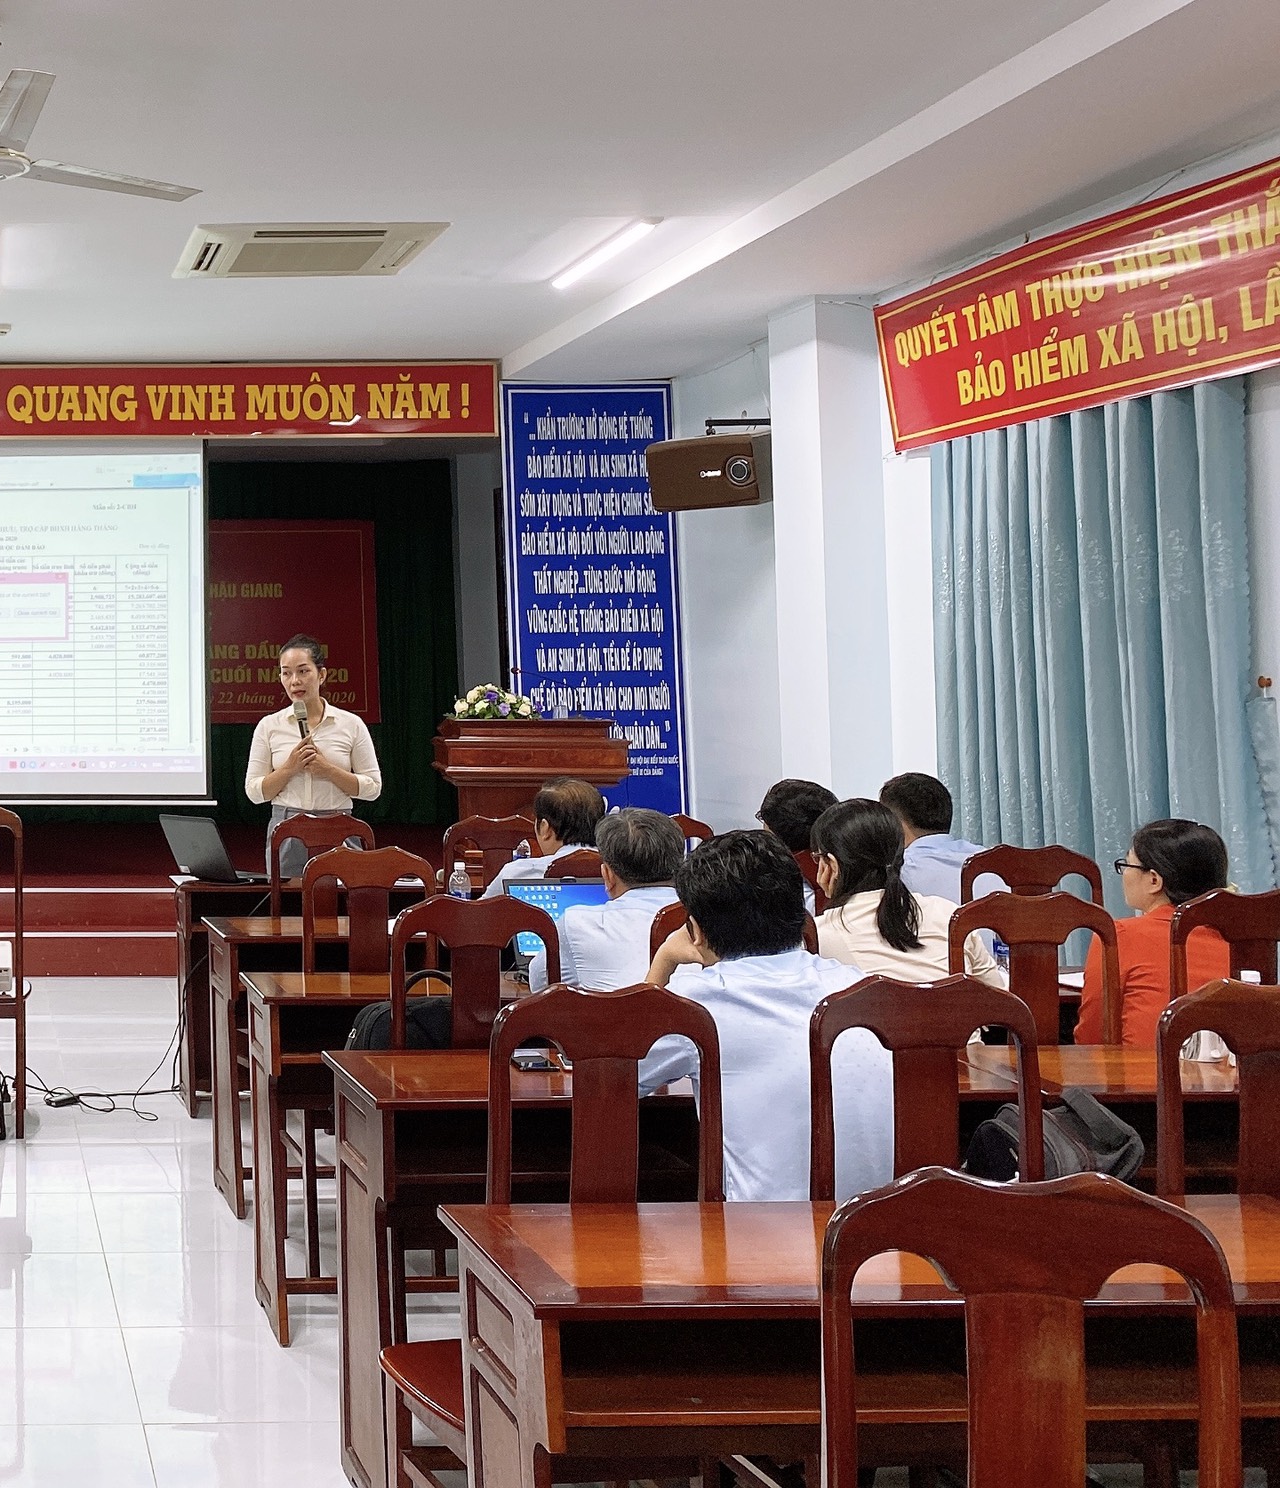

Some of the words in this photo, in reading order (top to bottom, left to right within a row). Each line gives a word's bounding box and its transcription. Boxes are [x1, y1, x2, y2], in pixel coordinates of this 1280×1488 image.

[894, 304, 958, 367] QUYẾT
[962, 293, 1021, 341] TÂM
[1026, 261, 1104, 320] THỰC
[1113, 228, 1202, 293] HIỆN
[956, 353, 1005, 405] BẢO
[1013, 327, 1089, 391] HIỂM
[1099, 313, 1144, 370] XÃ
[1151, 294, 1228, 357] HỘI,
[6, 385, 137, 424] QUANG
[146, 386, 235, 421] VINH
[245, 372, 356, 420] MUÔN
[367, 373, 451, 420] NĂM
[537, 406, 556, 440] KHẨN
[586, 408, 597, 440] MỞ
[599, 411, 617, 445] RỘNG
[619, 411, 628, 443] HỆ
[630, 408, 653, 439] THỐNG
[527, 447, 541, 478] BẢO
[543, 447, 561, 478] HIỂM
[563, 451, 572, 478] XÃ
[573, 450, 585, 483] HỘI
[589, 450, 599, 478] VÀ
[601, 455, 610, 477] AN
[611, 454, 628, 477] SINH
[628, 450, 638, 477] XÃ
[521, 488, 536, 517] SỚM
[537, 489, 551, 516] XÂY
[553, 492, 571, 521] DỰNG
[572, 488, 582, 516] VÀ
[583, 490, 603, 520] THỰC
[604, 488, 620, 520] HIỆN
[621, 488, 642, 516] CHÍNH
[522, 524, 535, 555] BẢO
[537, 522, 555, 555] HIỂM
[556, 528, 566, 555] XÃ
[568, 526, 580, 559] HỘI
[581, 524, 593, 554] ĐỐI
[630, 531, 644, 554] LAO
[645, 525, 665, 558] ĐỘNG
[241, 583, 282, 598] GIANG
[533, 563, 552, 594] THẤT
[604, 565, 623, 593] BƯỚC
[624, 561, 635, 593] MỞ
[637, 564, 656, 597] RỘNG
[527, 604, 548, 633] VỮNG
[549, 602, 568, 633] CHẮC
[569, 604, 579, 636] HỆ
[580, 602, 604, 633] THỐNG
[605, 599, 619, 632] BẢO
[620, 599, 639, 632] HIỂM
[640, 603, 650, 632] XÃ
[651, 603, 664, 637] HỘI
[536, 643, 547, 672] VÀ
[547, 649, 558, 672] AN
[559, 648, 574, 672] SINH
[576, 644, 586, 671] XÃ
[604, 640, 620, 671] TIỀN
[621, 640, 631, 671] ĐỀ
[632, 642, 642, 671] ÁP
[643, 647, 663, 675] DỤNG
[593, 683, 603, 711] XÃ
[604, 682, 617, 715] HỘI
[618, 687, 634, 710] CHO
[634, 687, 648, 715] MỌI
